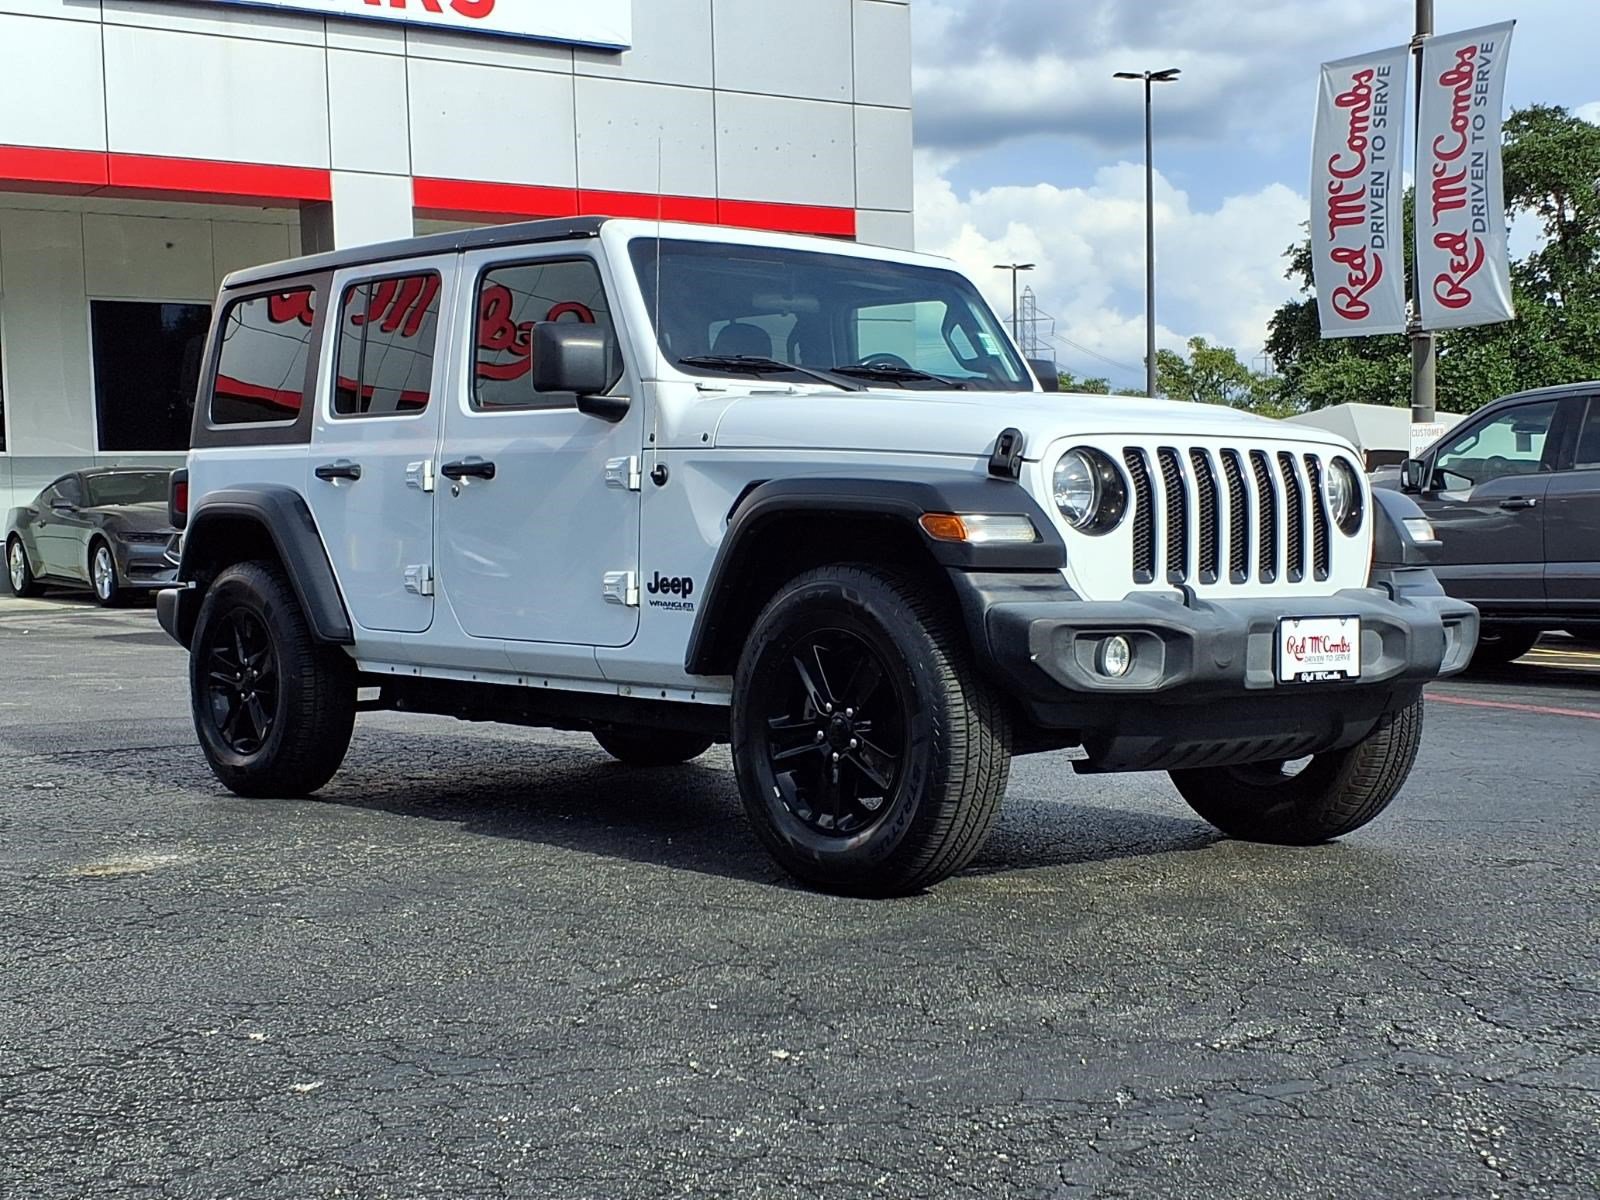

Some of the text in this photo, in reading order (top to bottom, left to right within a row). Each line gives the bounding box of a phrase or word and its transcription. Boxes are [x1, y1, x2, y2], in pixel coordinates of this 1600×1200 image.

[1371, 65, 1391, 249] DRIVEN TO SERVE
[1432, 45, 1485, 309] Red McCombs
[1472, 41, 1494, 233] DRIVEN TO SERVE
[1327, 69, 1383, 320] Red McCombs
[647, 571, 693, 599] Jeep
[648, 600, 694, 609] WRANGLER
[1287, 635, 1351, 661] Red McCombs
[1304, 654, 1351, 663] DRIVEN TO SERVE
